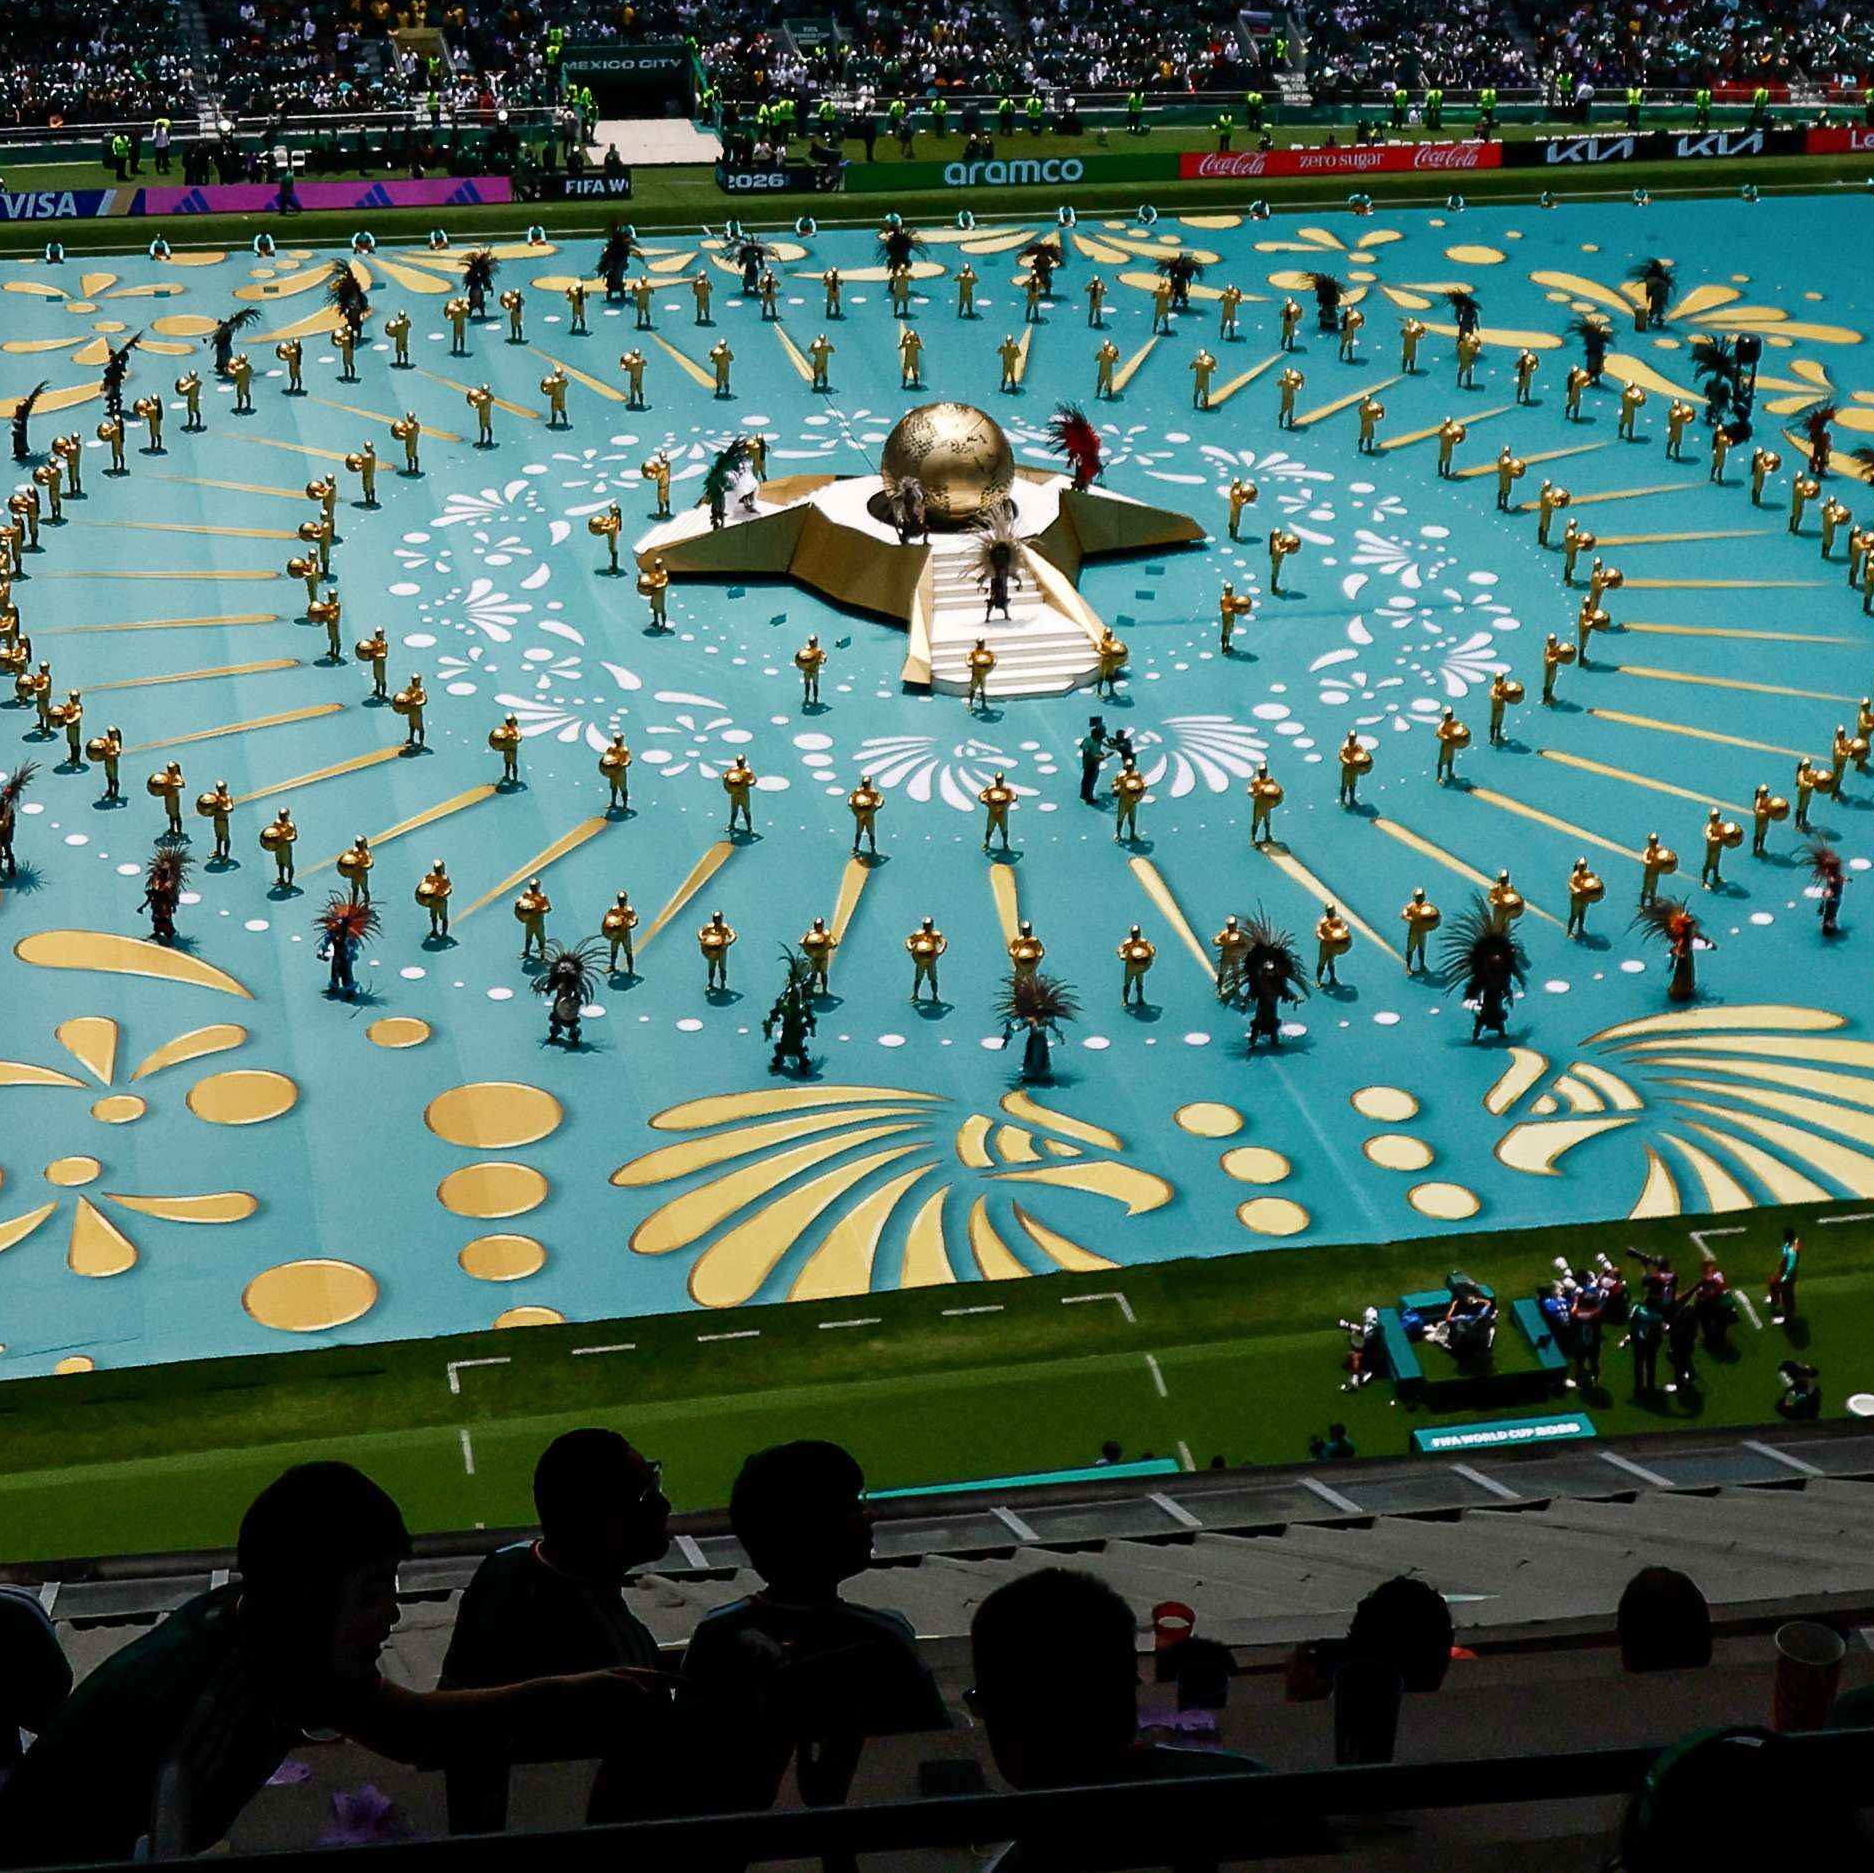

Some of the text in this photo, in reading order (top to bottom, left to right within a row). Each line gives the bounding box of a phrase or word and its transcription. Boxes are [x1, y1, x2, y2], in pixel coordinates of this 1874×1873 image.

[564, 57, 683, 72] MEXICO CITY
[944, 159, 1084, 187] aramco
[1299, 154, 1384, 176] zero sugar
[565, 179, 605, 195] FIFA
[0, 191, 78, 219] VISA
[1430, 1422, 1581, 1448] FIFA WORLD CUP 2026
